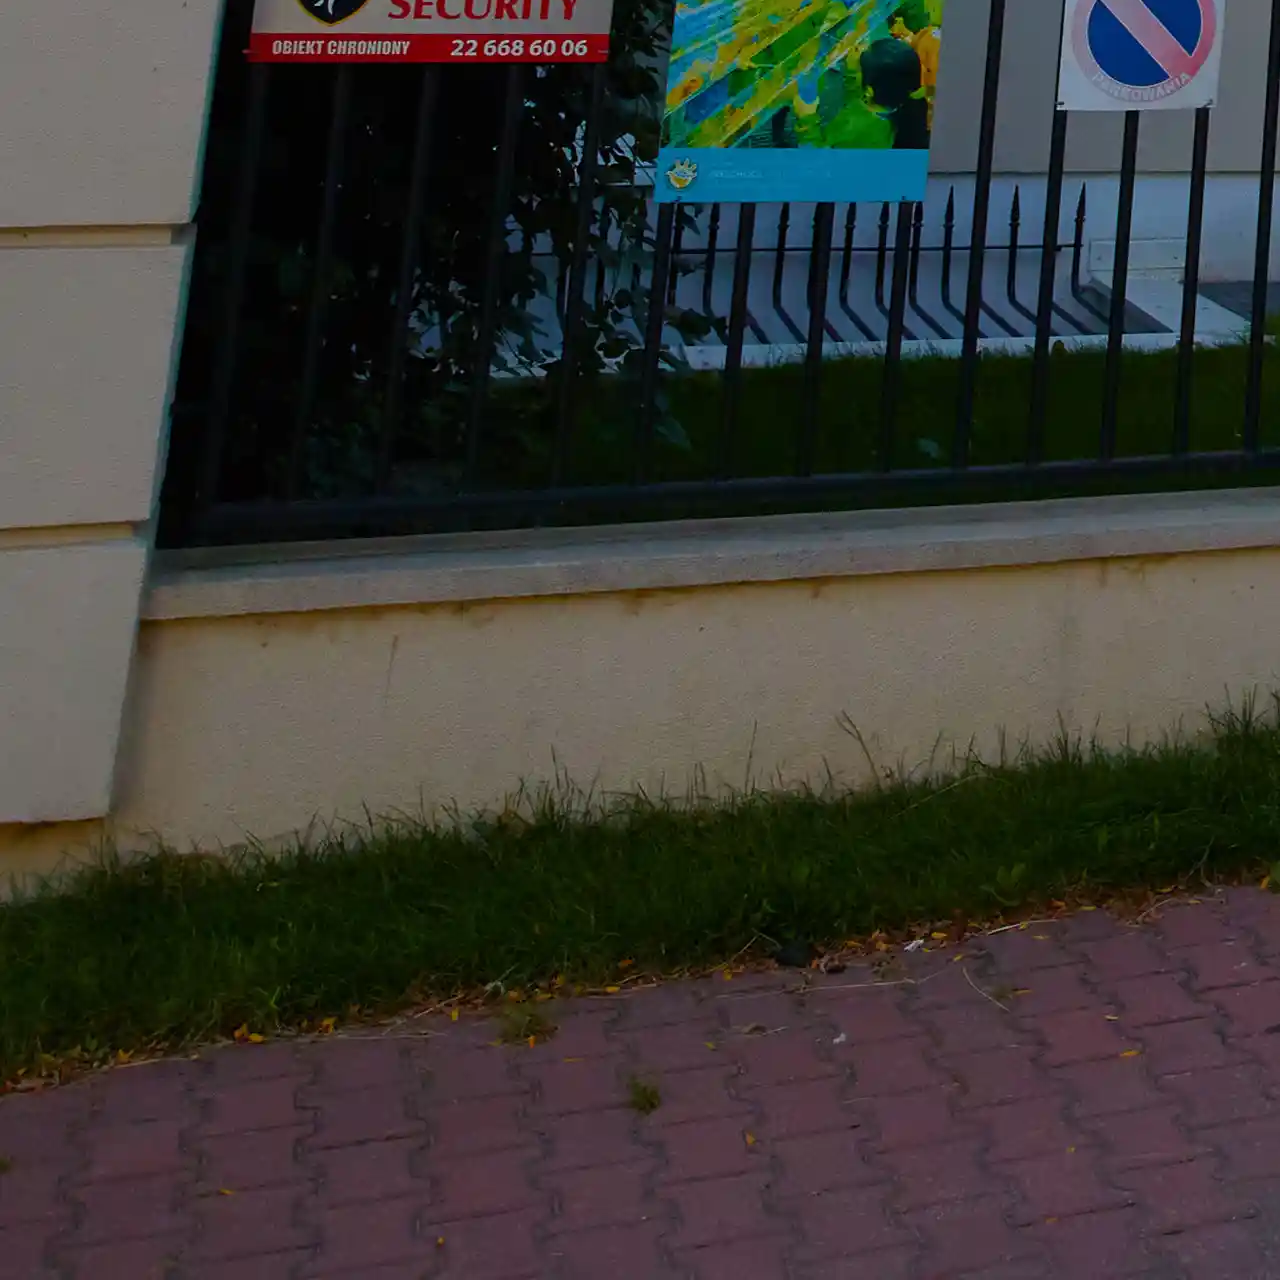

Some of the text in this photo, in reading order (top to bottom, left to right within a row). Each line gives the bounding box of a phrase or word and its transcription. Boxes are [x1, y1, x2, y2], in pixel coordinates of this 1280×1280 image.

[272, 40, 587, 56] OBIEKT CHRONIONY 22 668 60 06
[1091, 71, 1192, 101] PARKOWANIA
